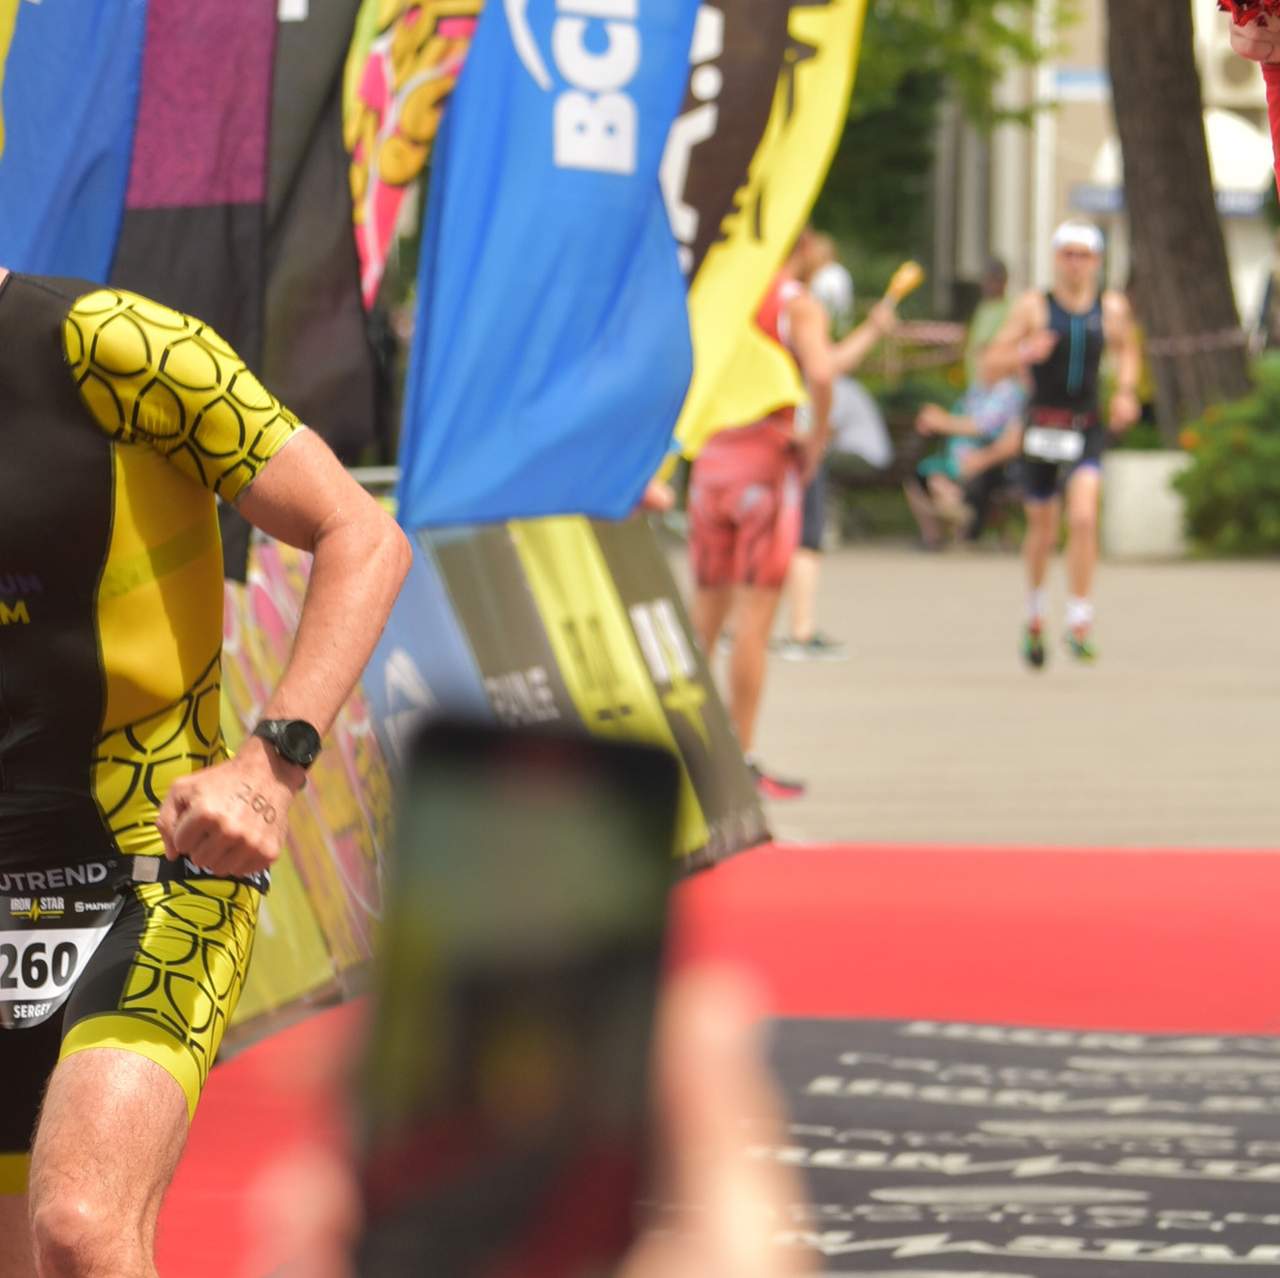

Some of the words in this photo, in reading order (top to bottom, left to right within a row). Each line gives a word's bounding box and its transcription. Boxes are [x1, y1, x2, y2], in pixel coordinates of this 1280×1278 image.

[10, 898, 31, 911] IRON
[39, 896, 65, 910] STAR
[0, 941, 79, 990] 260
[13, 1002, 52, 1019] SERGEY
